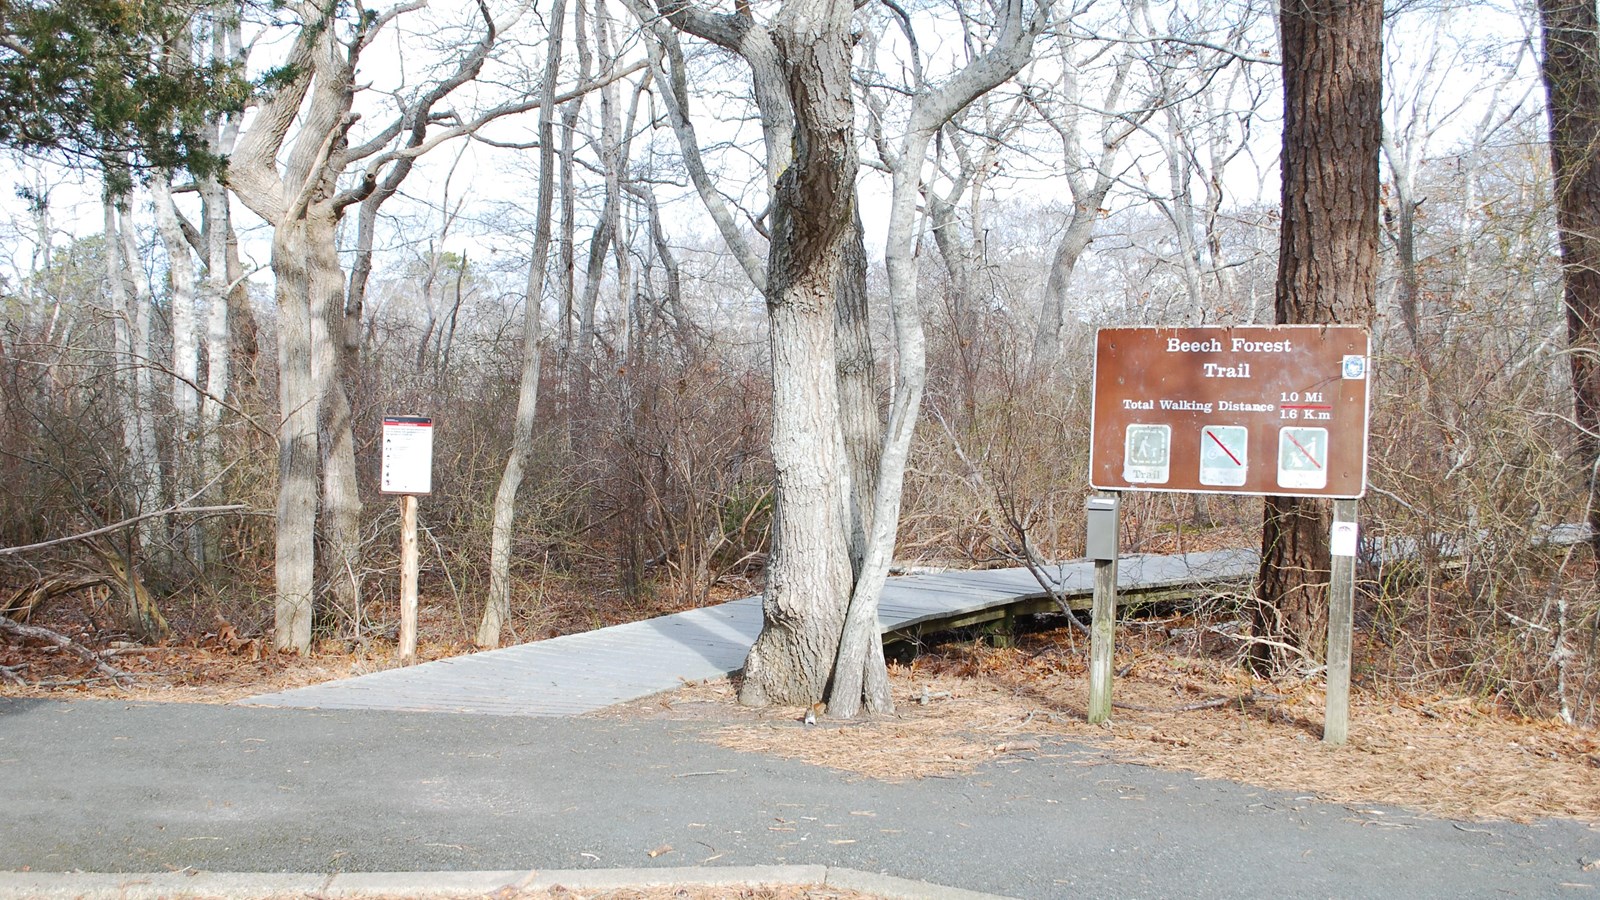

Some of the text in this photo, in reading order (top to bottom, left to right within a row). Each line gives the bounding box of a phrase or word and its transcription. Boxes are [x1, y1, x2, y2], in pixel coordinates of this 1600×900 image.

[1166, 338, 1292, 352] Beech Forest
[1203, 363, 1251, 378] Trail
[1280, 391, 1323, 402] 1.0 Mi
[1123, 399, 1274, 413] Total Walking Distance
[1280, 408, 1298, 419] 1.6
[1132, 469, 1160, 479] Trail
